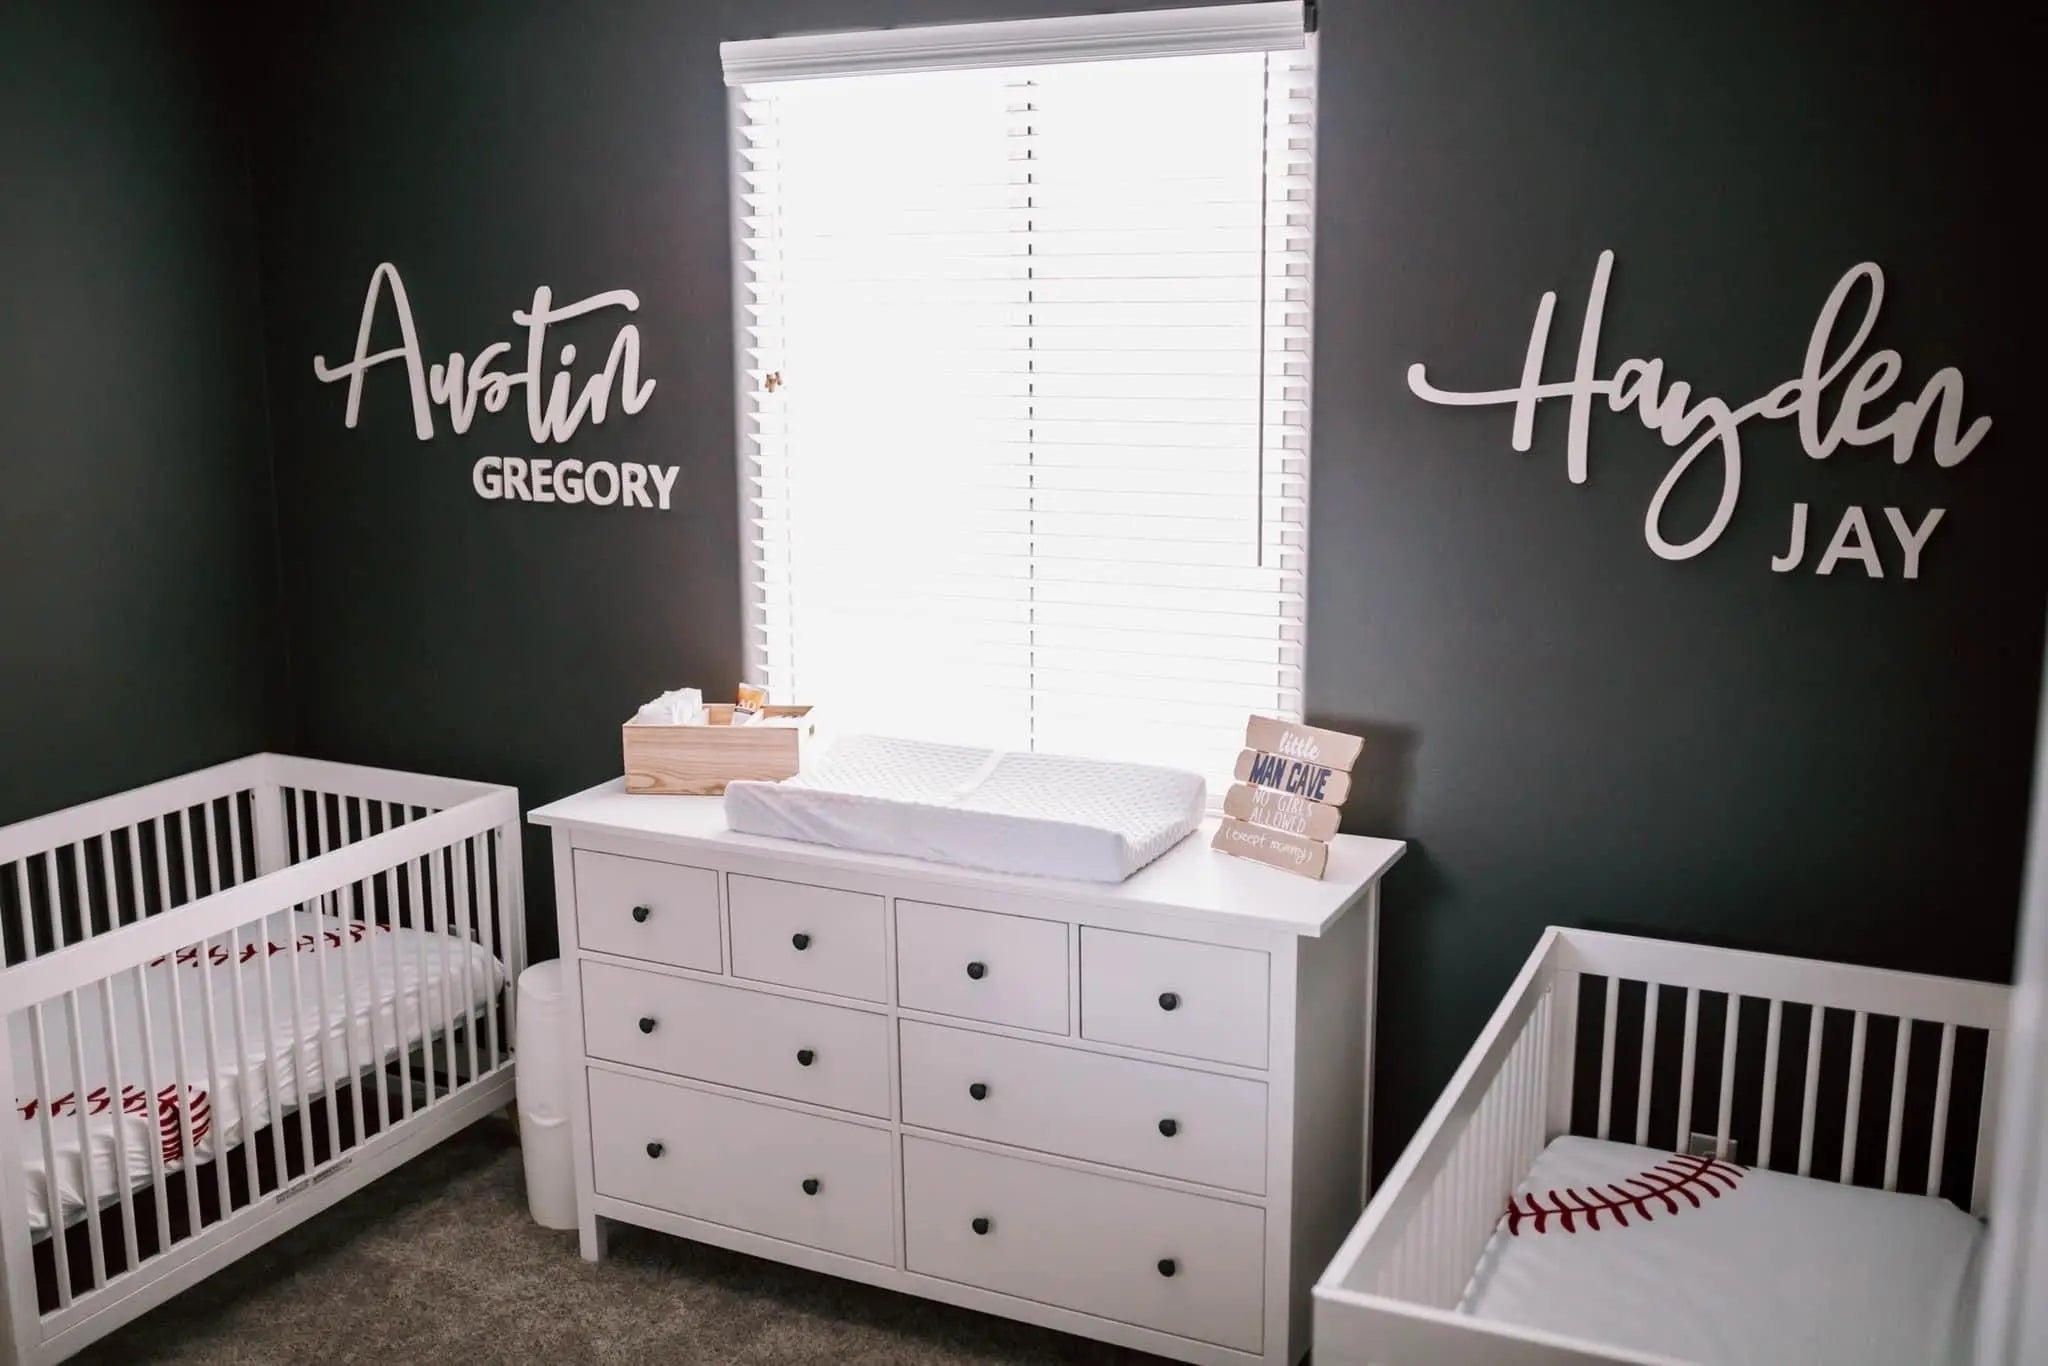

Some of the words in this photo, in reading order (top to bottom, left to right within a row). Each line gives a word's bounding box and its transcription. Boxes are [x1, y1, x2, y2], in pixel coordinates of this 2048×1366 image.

[314, 262, 656, 443] Austin
[1407, 249, 1992, 561] Hayden
[472, 456, 680, 510] GREGORY
[1771, 502, 1946, 579] JAY
[1279, 730, 1321, 760] little
[1249, 753, 1287, 789] MAN
[1286, 762, 1332, 800] CAVE
[1252, 789, 1270, 807] NO
[1249, 806, 1307, 833] ALLOWED
